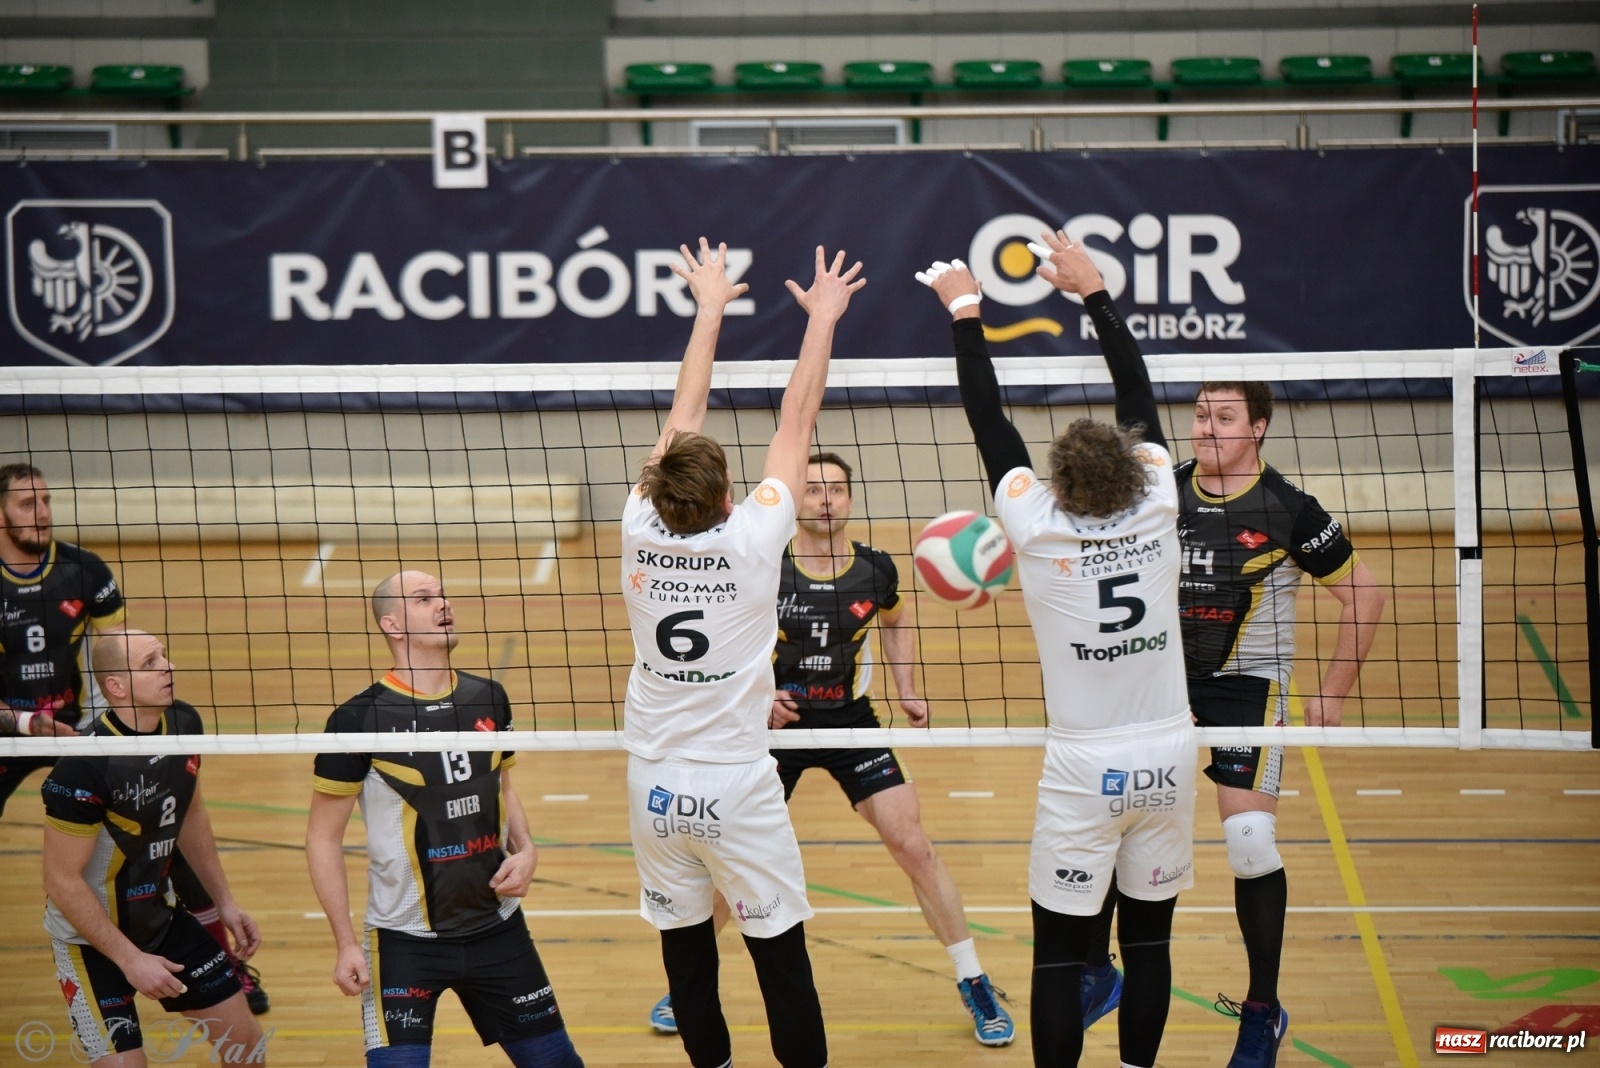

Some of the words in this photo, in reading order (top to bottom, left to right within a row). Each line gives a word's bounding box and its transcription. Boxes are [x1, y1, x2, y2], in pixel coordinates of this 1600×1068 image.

[443, 130, 479, 170] B
[269, 226, 756, 320] RACIBÓRZ
[1080, 305, 1247, 341] RCIBÓRZ
[636, 550, 731, 571] SKORUPA
[1081, 549, 1163, 578] LUNATYCY
[1181, 546, 1215, 575] 14
[650, 591, 738, 604] LUNATYCY
[1098, 572, 1146, 634] 5
[26, 624, 46, 653] 8
[655, 609, 710, 662] 6
[810, 622, 830, 648] 4
[1069, 630, 1168, 663] TropiDog
[21, 661, 55, 681] ENTER
[440, 750, 473, 785] 13
[1133, 765, 1177, 791] DK
[159, 795, 176, 828] 2
[446, 794, 481, 820] ENTER
[677, 793, 721, 821] DK
[1109, 790, 1177, 818] glass
[653, 812, 722, 839] glass
